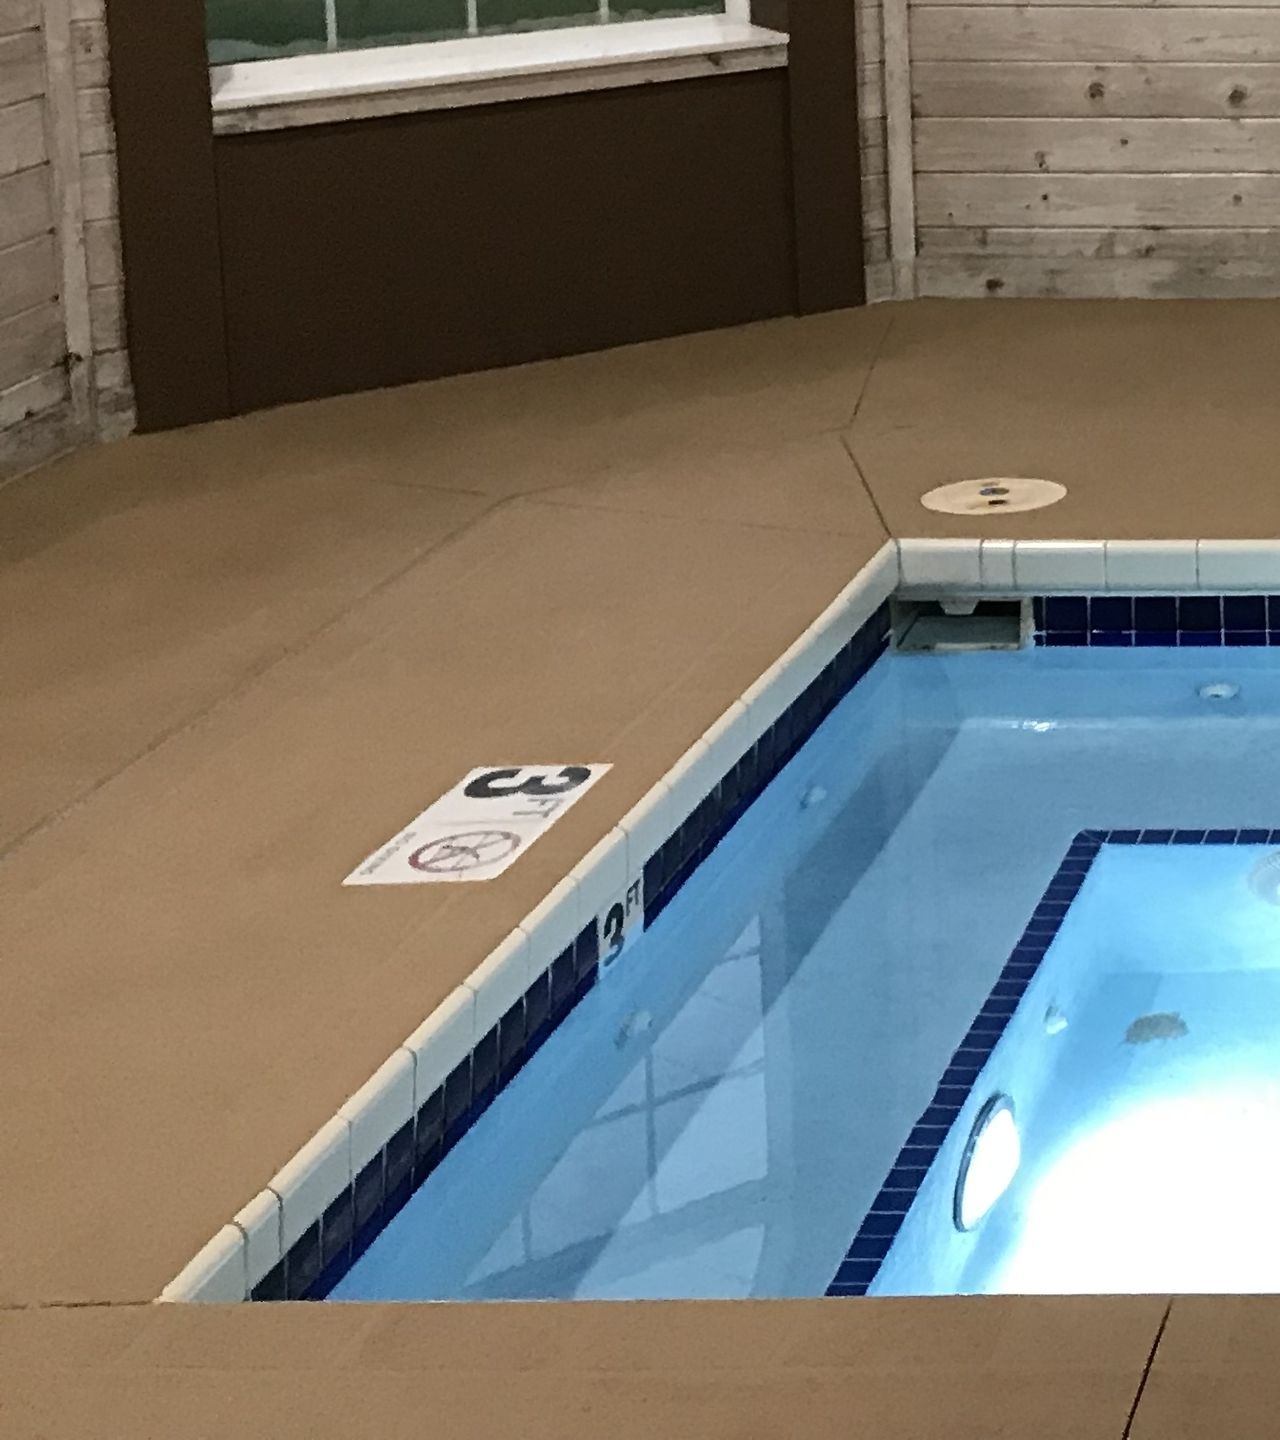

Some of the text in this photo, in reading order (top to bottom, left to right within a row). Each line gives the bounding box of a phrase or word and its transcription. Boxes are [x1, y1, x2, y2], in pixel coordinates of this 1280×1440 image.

[464, 766, 591, 818] 3 FT
[603, 879, 640, 967] 3 FT
